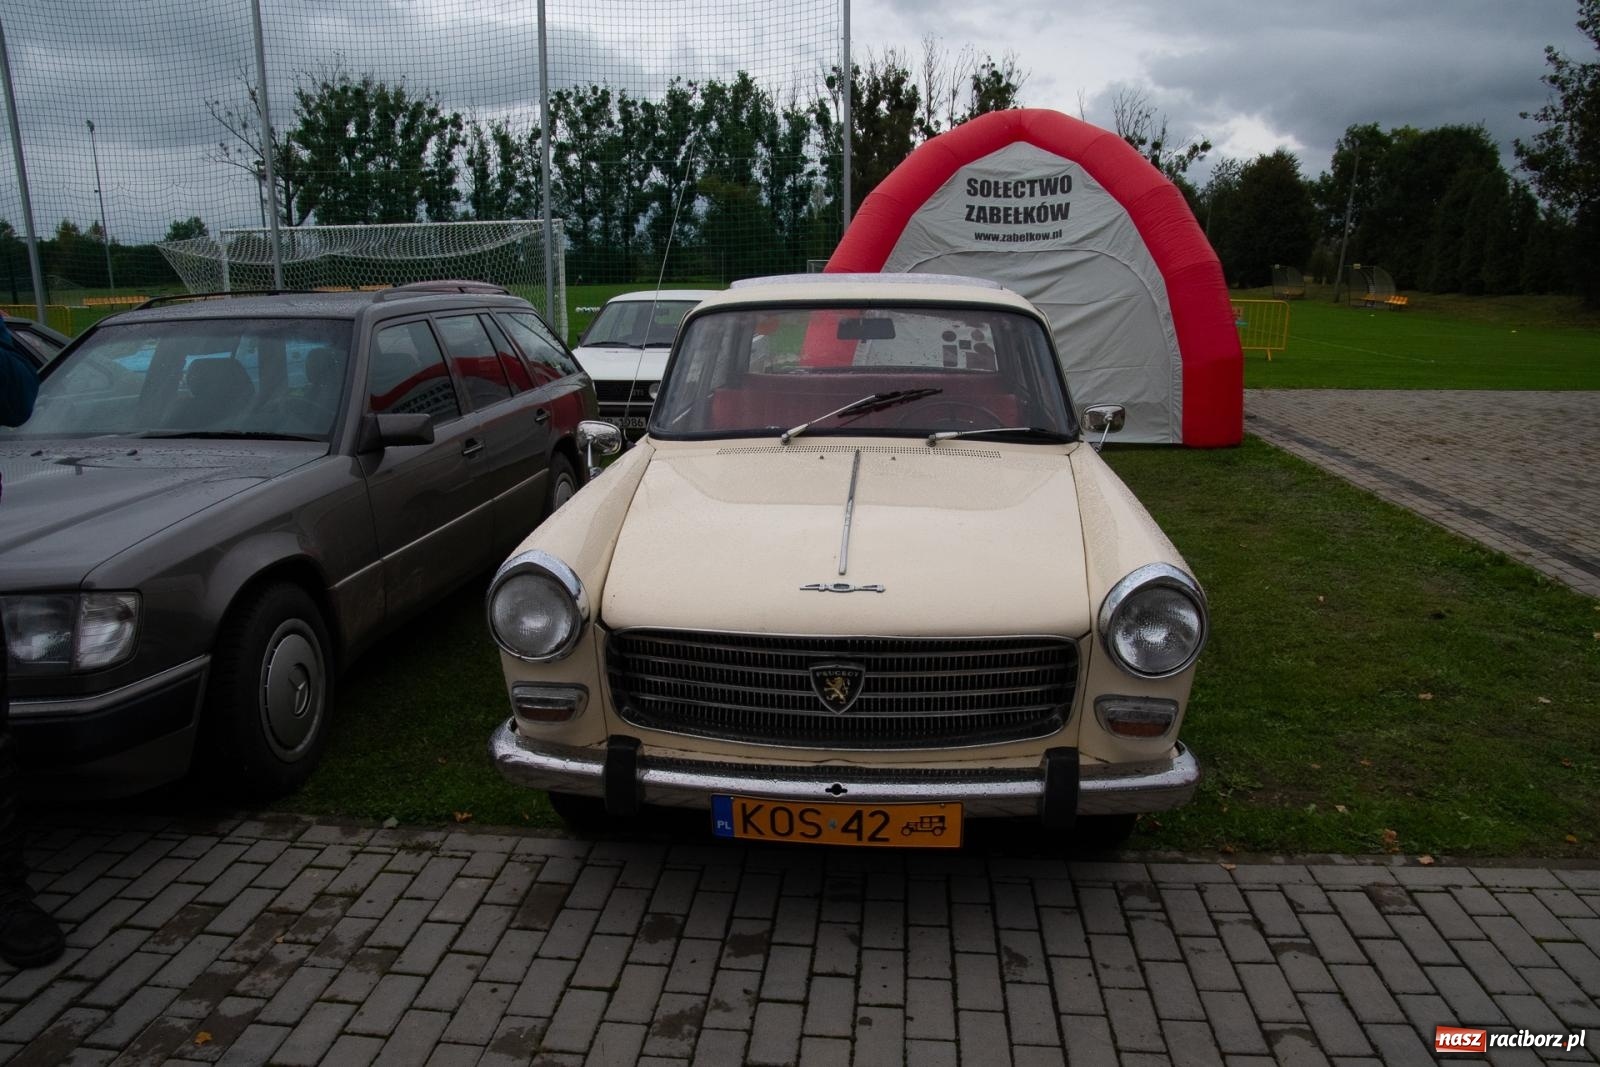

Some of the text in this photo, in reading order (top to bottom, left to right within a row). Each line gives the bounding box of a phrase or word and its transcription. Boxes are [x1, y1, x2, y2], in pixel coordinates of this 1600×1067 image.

[966, 174, 1073, 199] SOŁECTWO
[965, 202, 1071, 225] ZABEŁKÓW
[717, 820, 732, 831] PL
[740, 803, 890, 842] KOS 42
